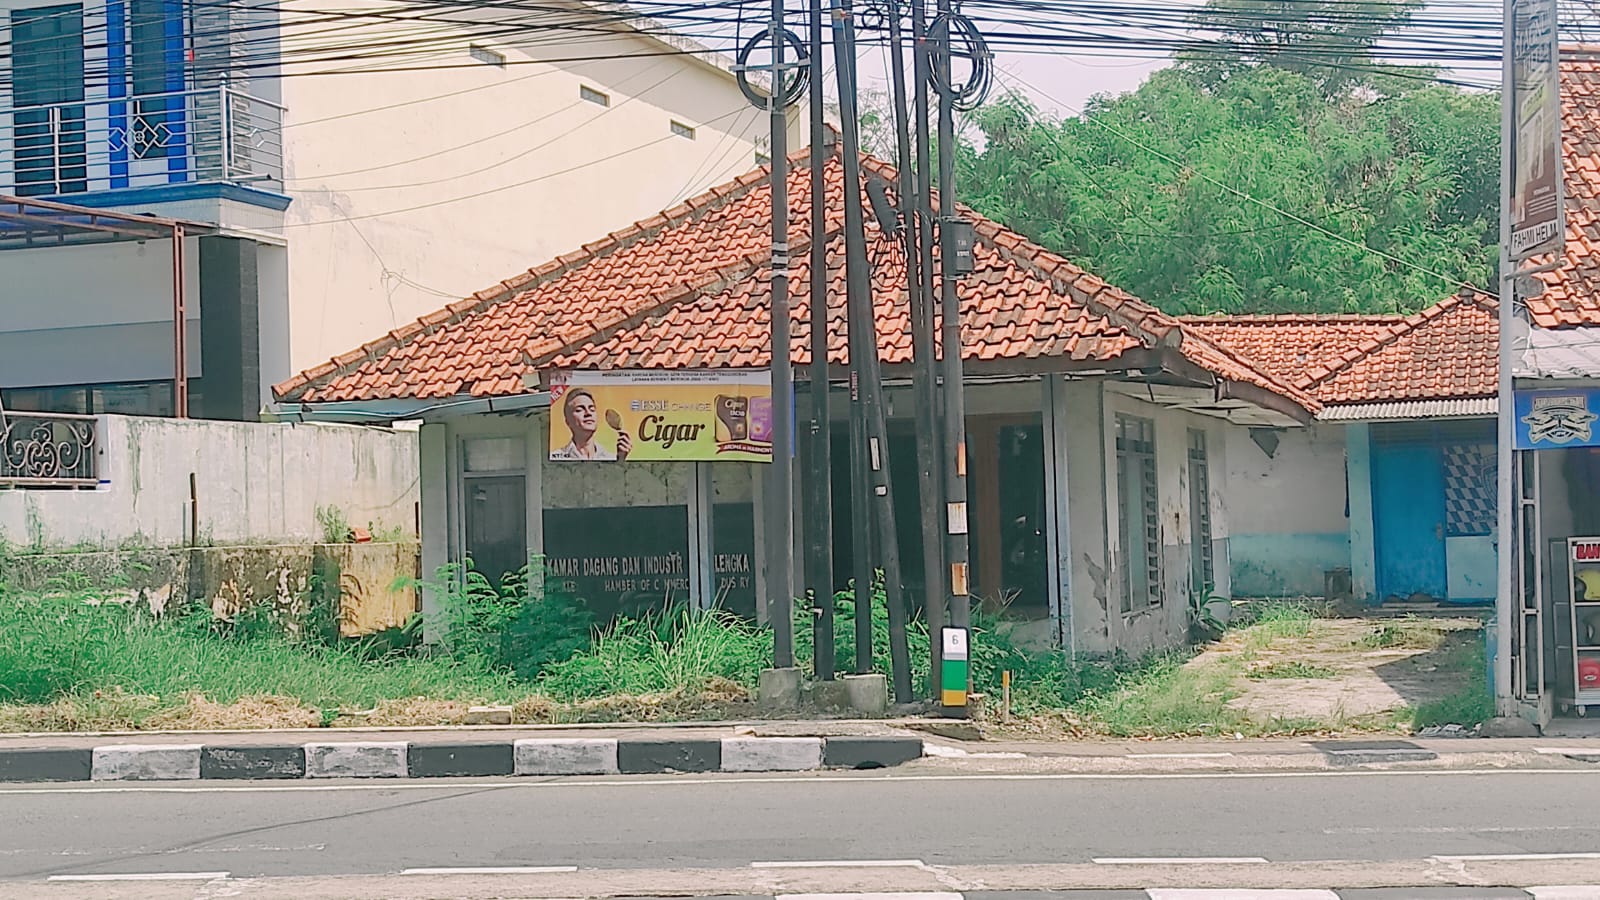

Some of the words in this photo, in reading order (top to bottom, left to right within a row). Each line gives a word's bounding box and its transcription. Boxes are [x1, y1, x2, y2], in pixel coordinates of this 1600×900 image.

[1513, 229, 1535, 248] FAHMI
[551, 386, 564, 400] NEW
[640, 399, 668, 412] ESSE
[638, 414, 705, 449] Cigar
[546, 558, 579, 576] KAMAR
[583, 557, 619, 576] DAGANG
[622, 556, 641, 575] DAN
[641, 580, 651, 591] OF
[951, 634, 959, 646] 6
